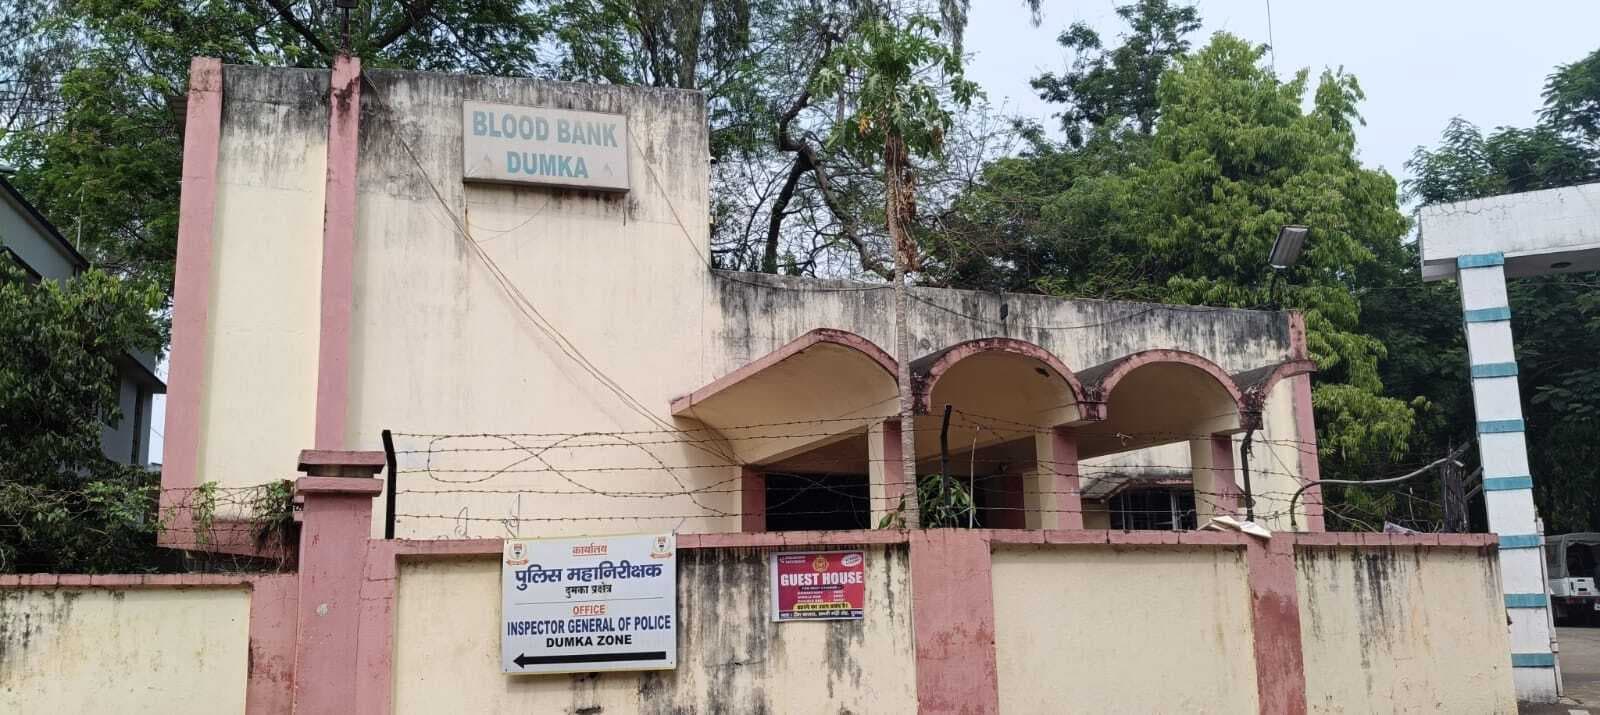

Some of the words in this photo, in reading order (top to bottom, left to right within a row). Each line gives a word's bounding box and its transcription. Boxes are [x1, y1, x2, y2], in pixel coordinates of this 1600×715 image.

[472, 111, 549, 141] BLOOD
[557, 119, 618, 148] BANK
[506, 151, 589, 178] DUMKA
[572, 543, 609, 555] कार्यालय
[515, 563, 562, 591] पुलिस
[567, 560, 664, 582] महानिरीक्षक
[780, 573, 819, 586] GUEST
[822, 572, 863, 584] HOUSE
[565, 584, 589, 598] दुमका
[591, 582, 613, 594] प्रक्षेत्र
[572, 604, 606, 615] OFFICE
[507, 620, 565, 636] INSPECTOR
[568, 617, 615, 633] GENERAL
[618, 617, 631, 631] OF
[635, 615, 671, 631] POLICE
[546, 636, 593, 648] DUMKA
[597, 634, 632, 646] ZONE
